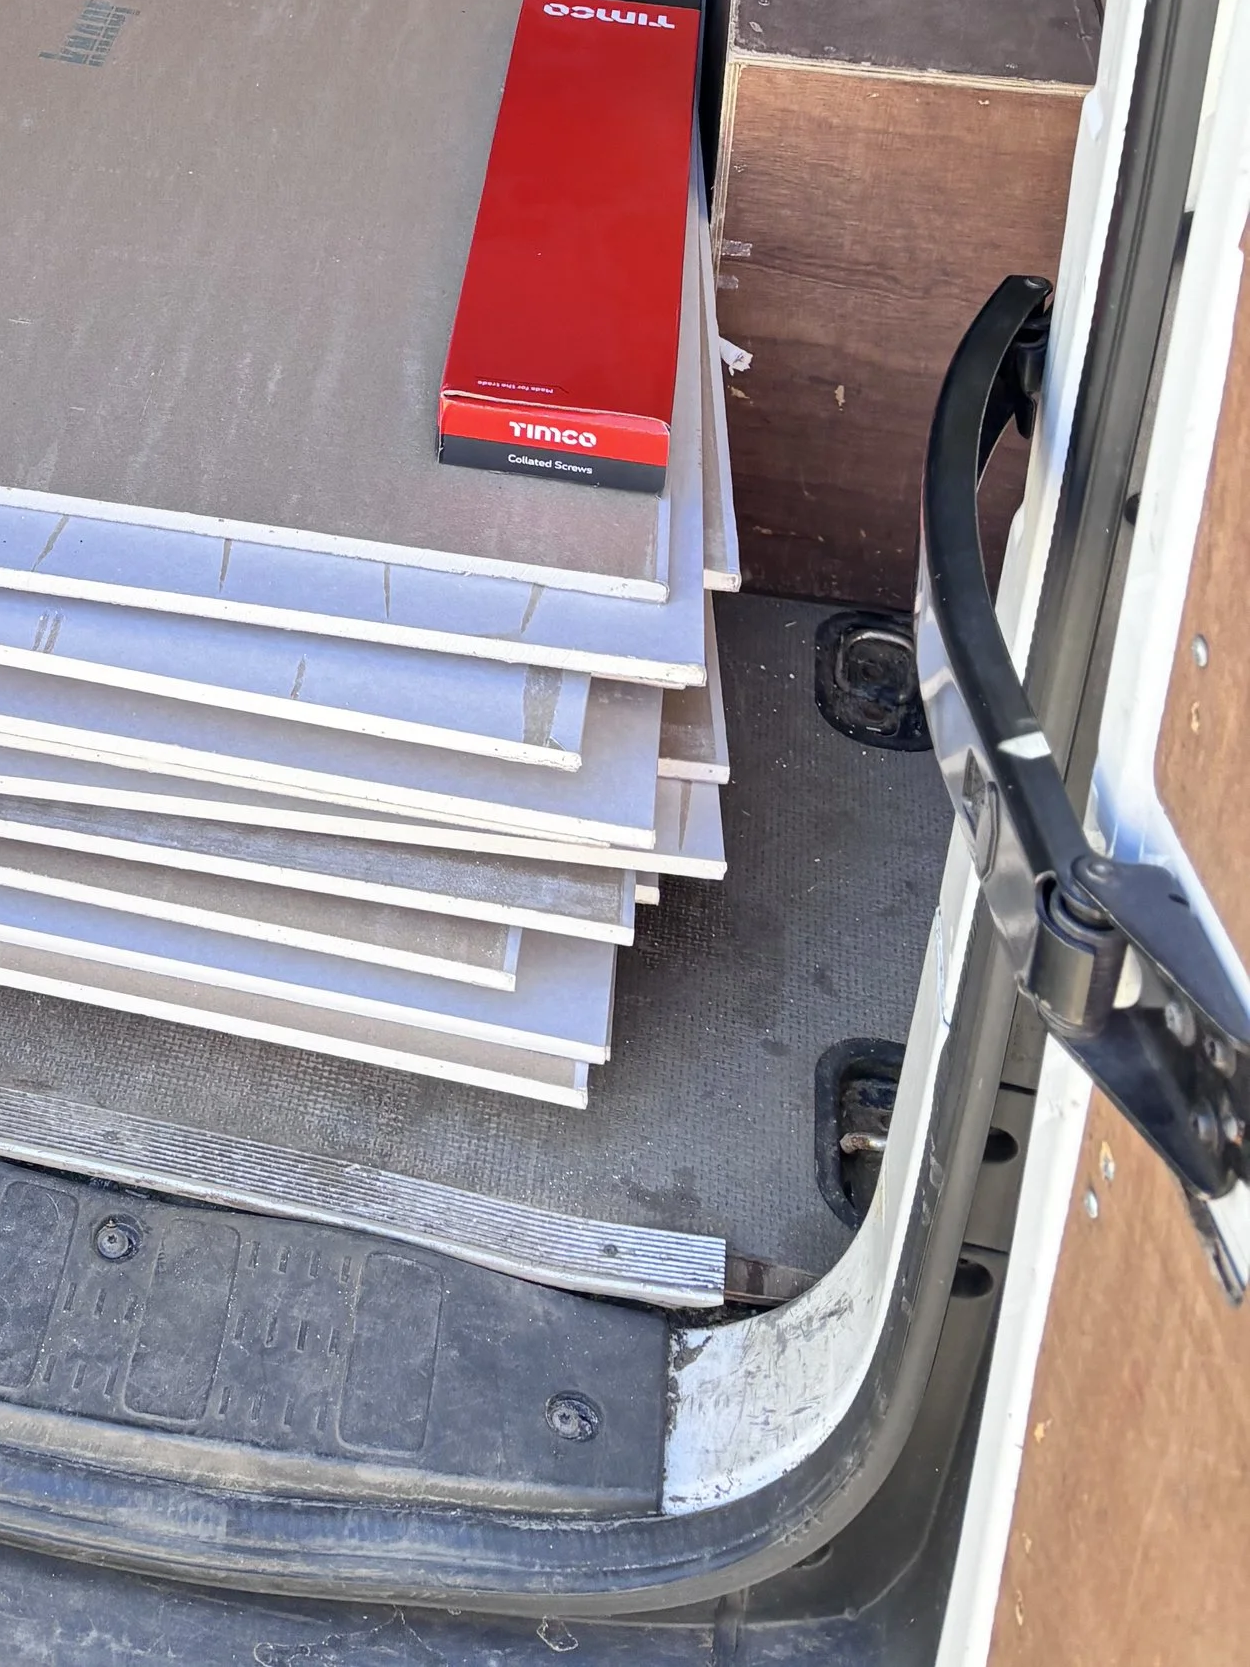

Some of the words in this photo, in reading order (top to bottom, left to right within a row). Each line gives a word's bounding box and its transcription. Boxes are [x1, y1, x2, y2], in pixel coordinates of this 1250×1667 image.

[477, 380, 501, 388] trade
[501, 382, 516, 390] the
[530, 387, 554, 395] Made
[507, 453, 553, 468] Collated
[554, 459, 593, 475] Screws
